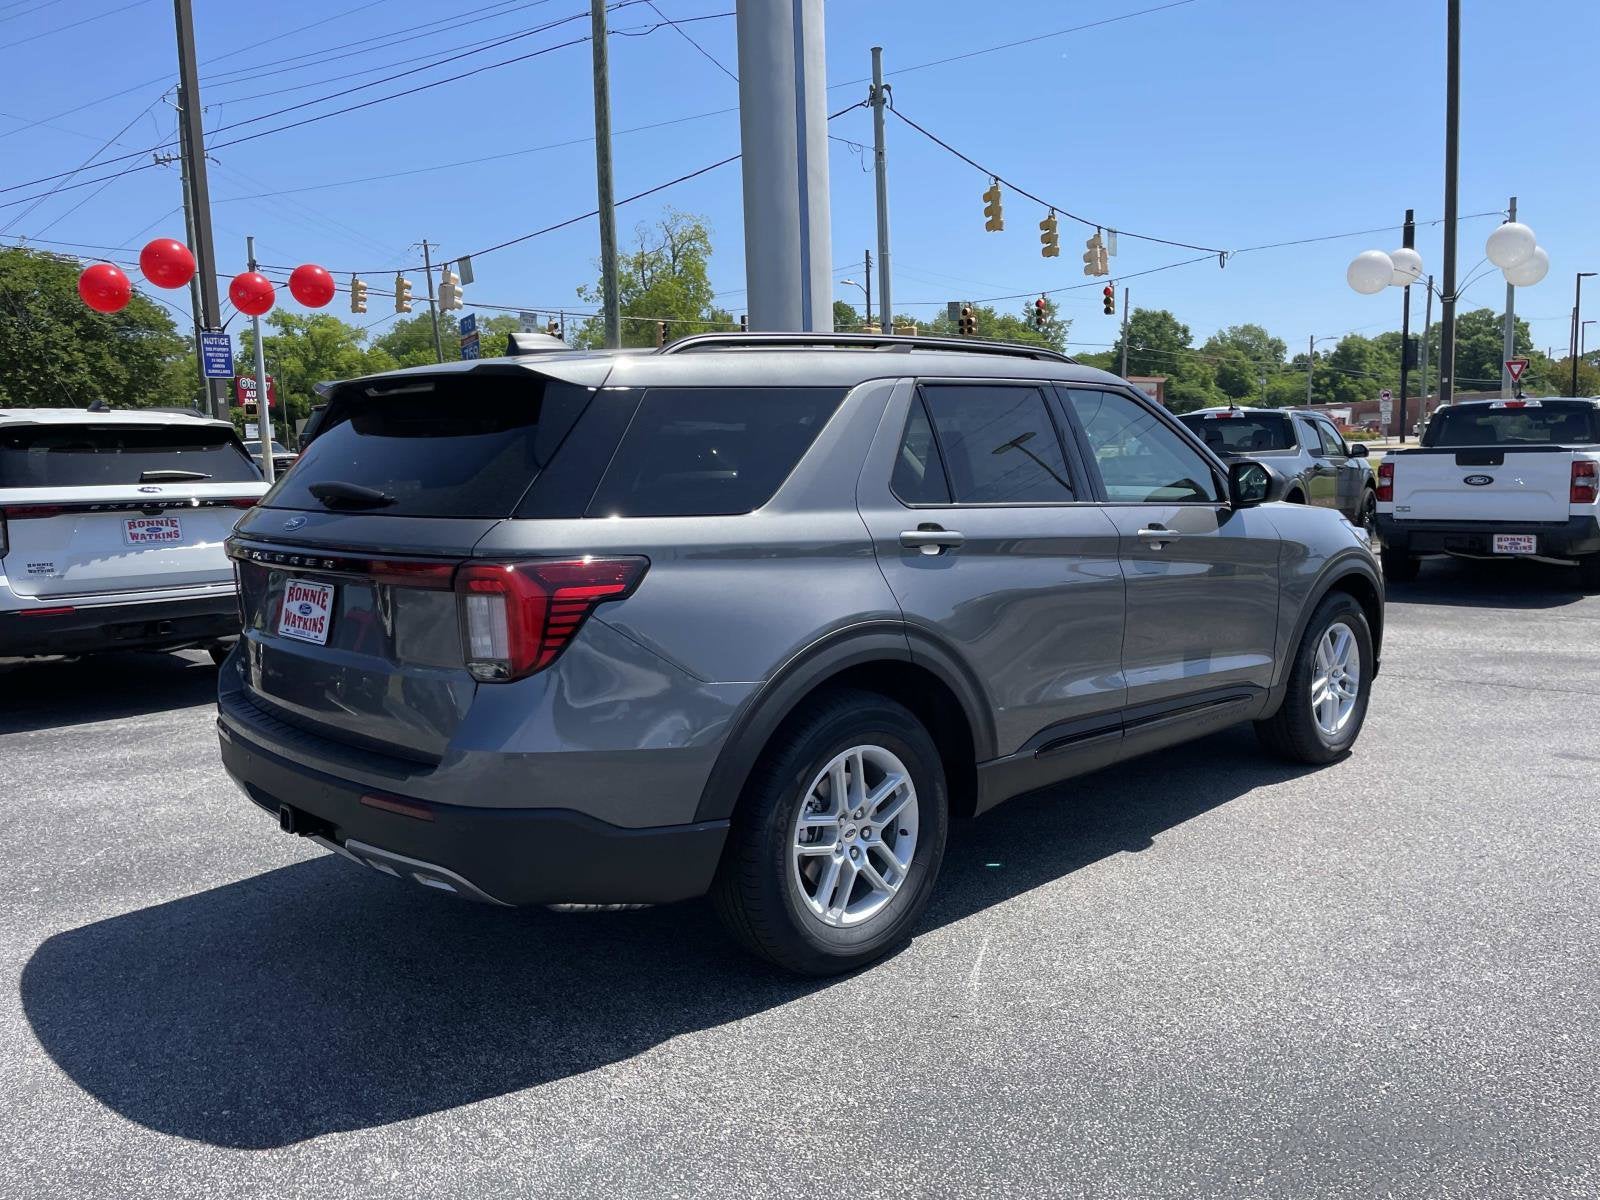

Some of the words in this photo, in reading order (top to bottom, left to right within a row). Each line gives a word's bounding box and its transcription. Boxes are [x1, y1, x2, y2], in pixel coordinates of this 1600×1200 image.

[204, 337, 229, 346] NOTICE
[91, 501, 215, 510] EXPLORR
[128, 519, 179, 529] RONNIE
[130, 529, 181, 541] WATKINS
[1497, 543, 1533, 551] WATKINS
[287, 586, 328, 611] RONNIE
[284, 607, 326, 634] WATKINS
